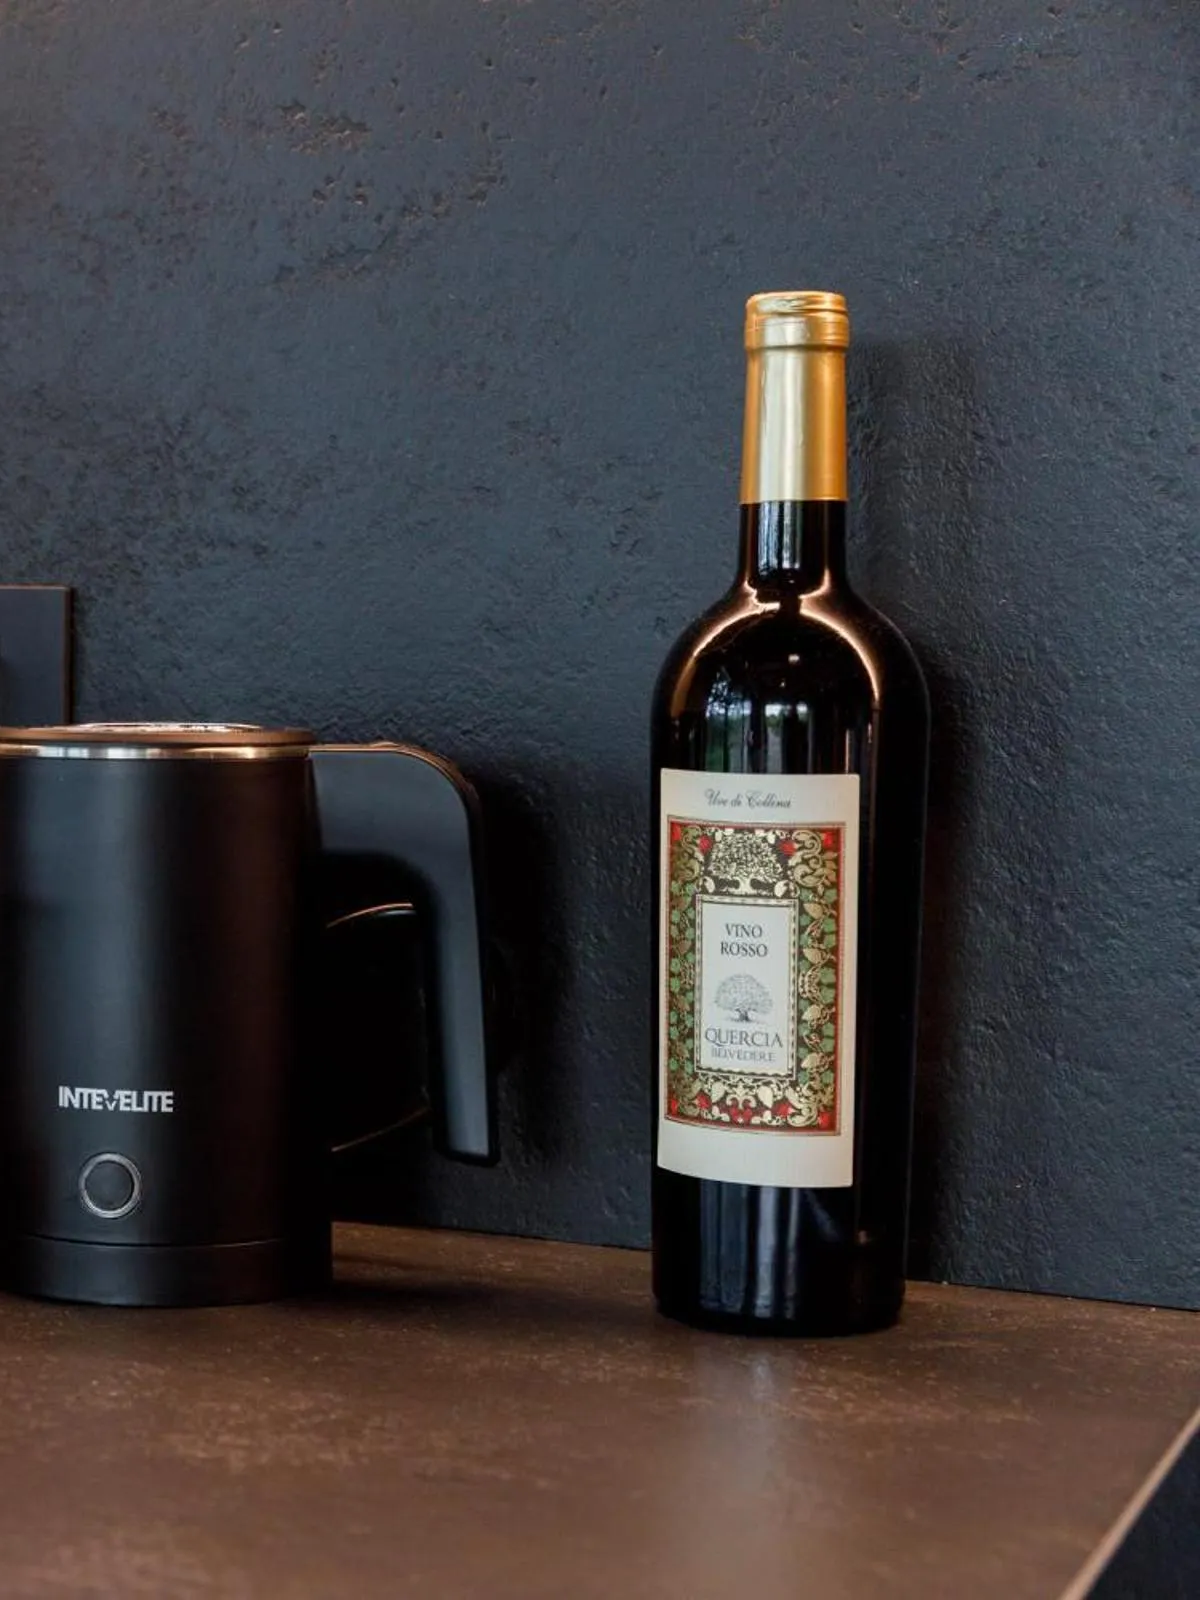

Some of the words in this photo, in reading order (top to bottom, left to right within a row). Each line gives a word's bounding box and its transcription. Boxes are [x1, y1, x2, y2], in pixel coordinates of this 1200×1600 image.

[704, 788, 728, 807] Uve
[730, 792, 743, 808] di
[744, 788, 792, 810] Collina
[725, 923, 763, 939] VINO
[720, 941, 768, 958] ROSSO
[704, 1027, 783, 1049] QUERCIA
[711, 1047, 777, 1062] BELVEDERE
